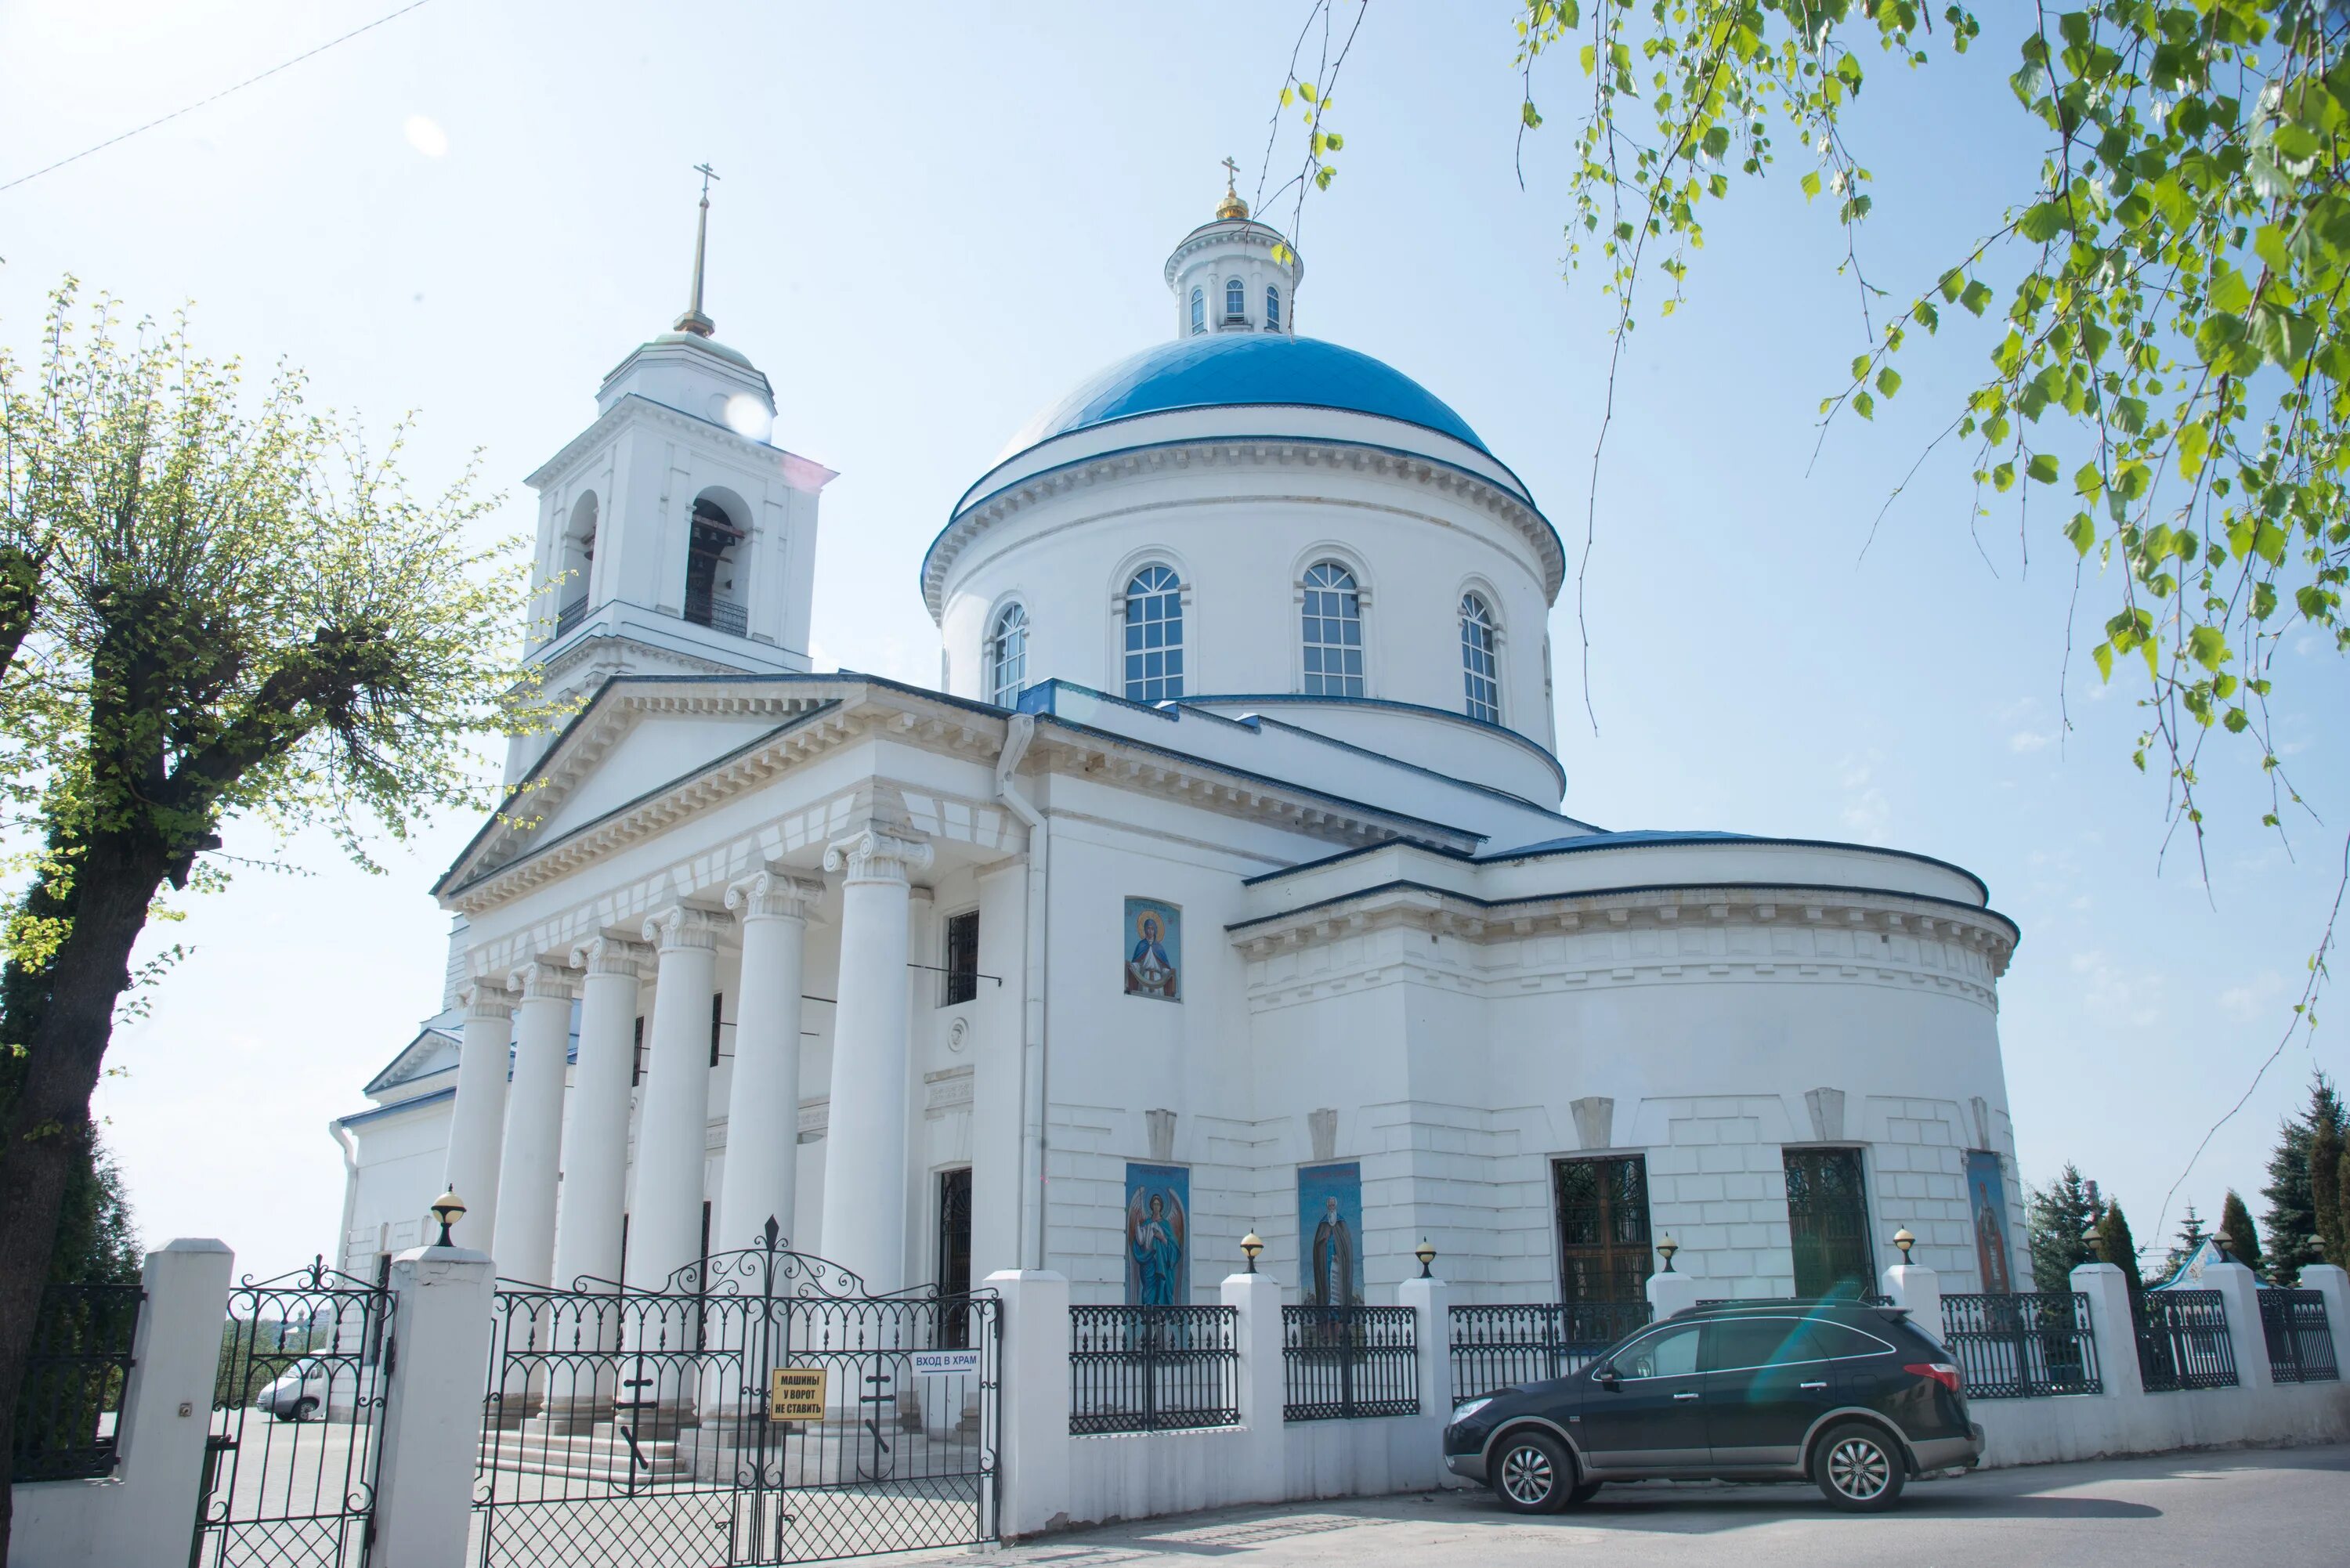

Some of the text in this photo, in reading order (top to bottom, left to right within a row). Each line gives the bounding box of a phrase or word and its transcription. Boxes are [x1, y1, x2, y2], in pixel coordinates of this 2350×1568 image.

[916, 1355, 977, 1367] ВХОД В ХРАМ
[781, 1375, 820, 1386] МАШИНЫ
[783, 1389, 815, 1400] У ВОРОТ
[775, 1404, 821, 1414] НЕ СТАВИТЬ
